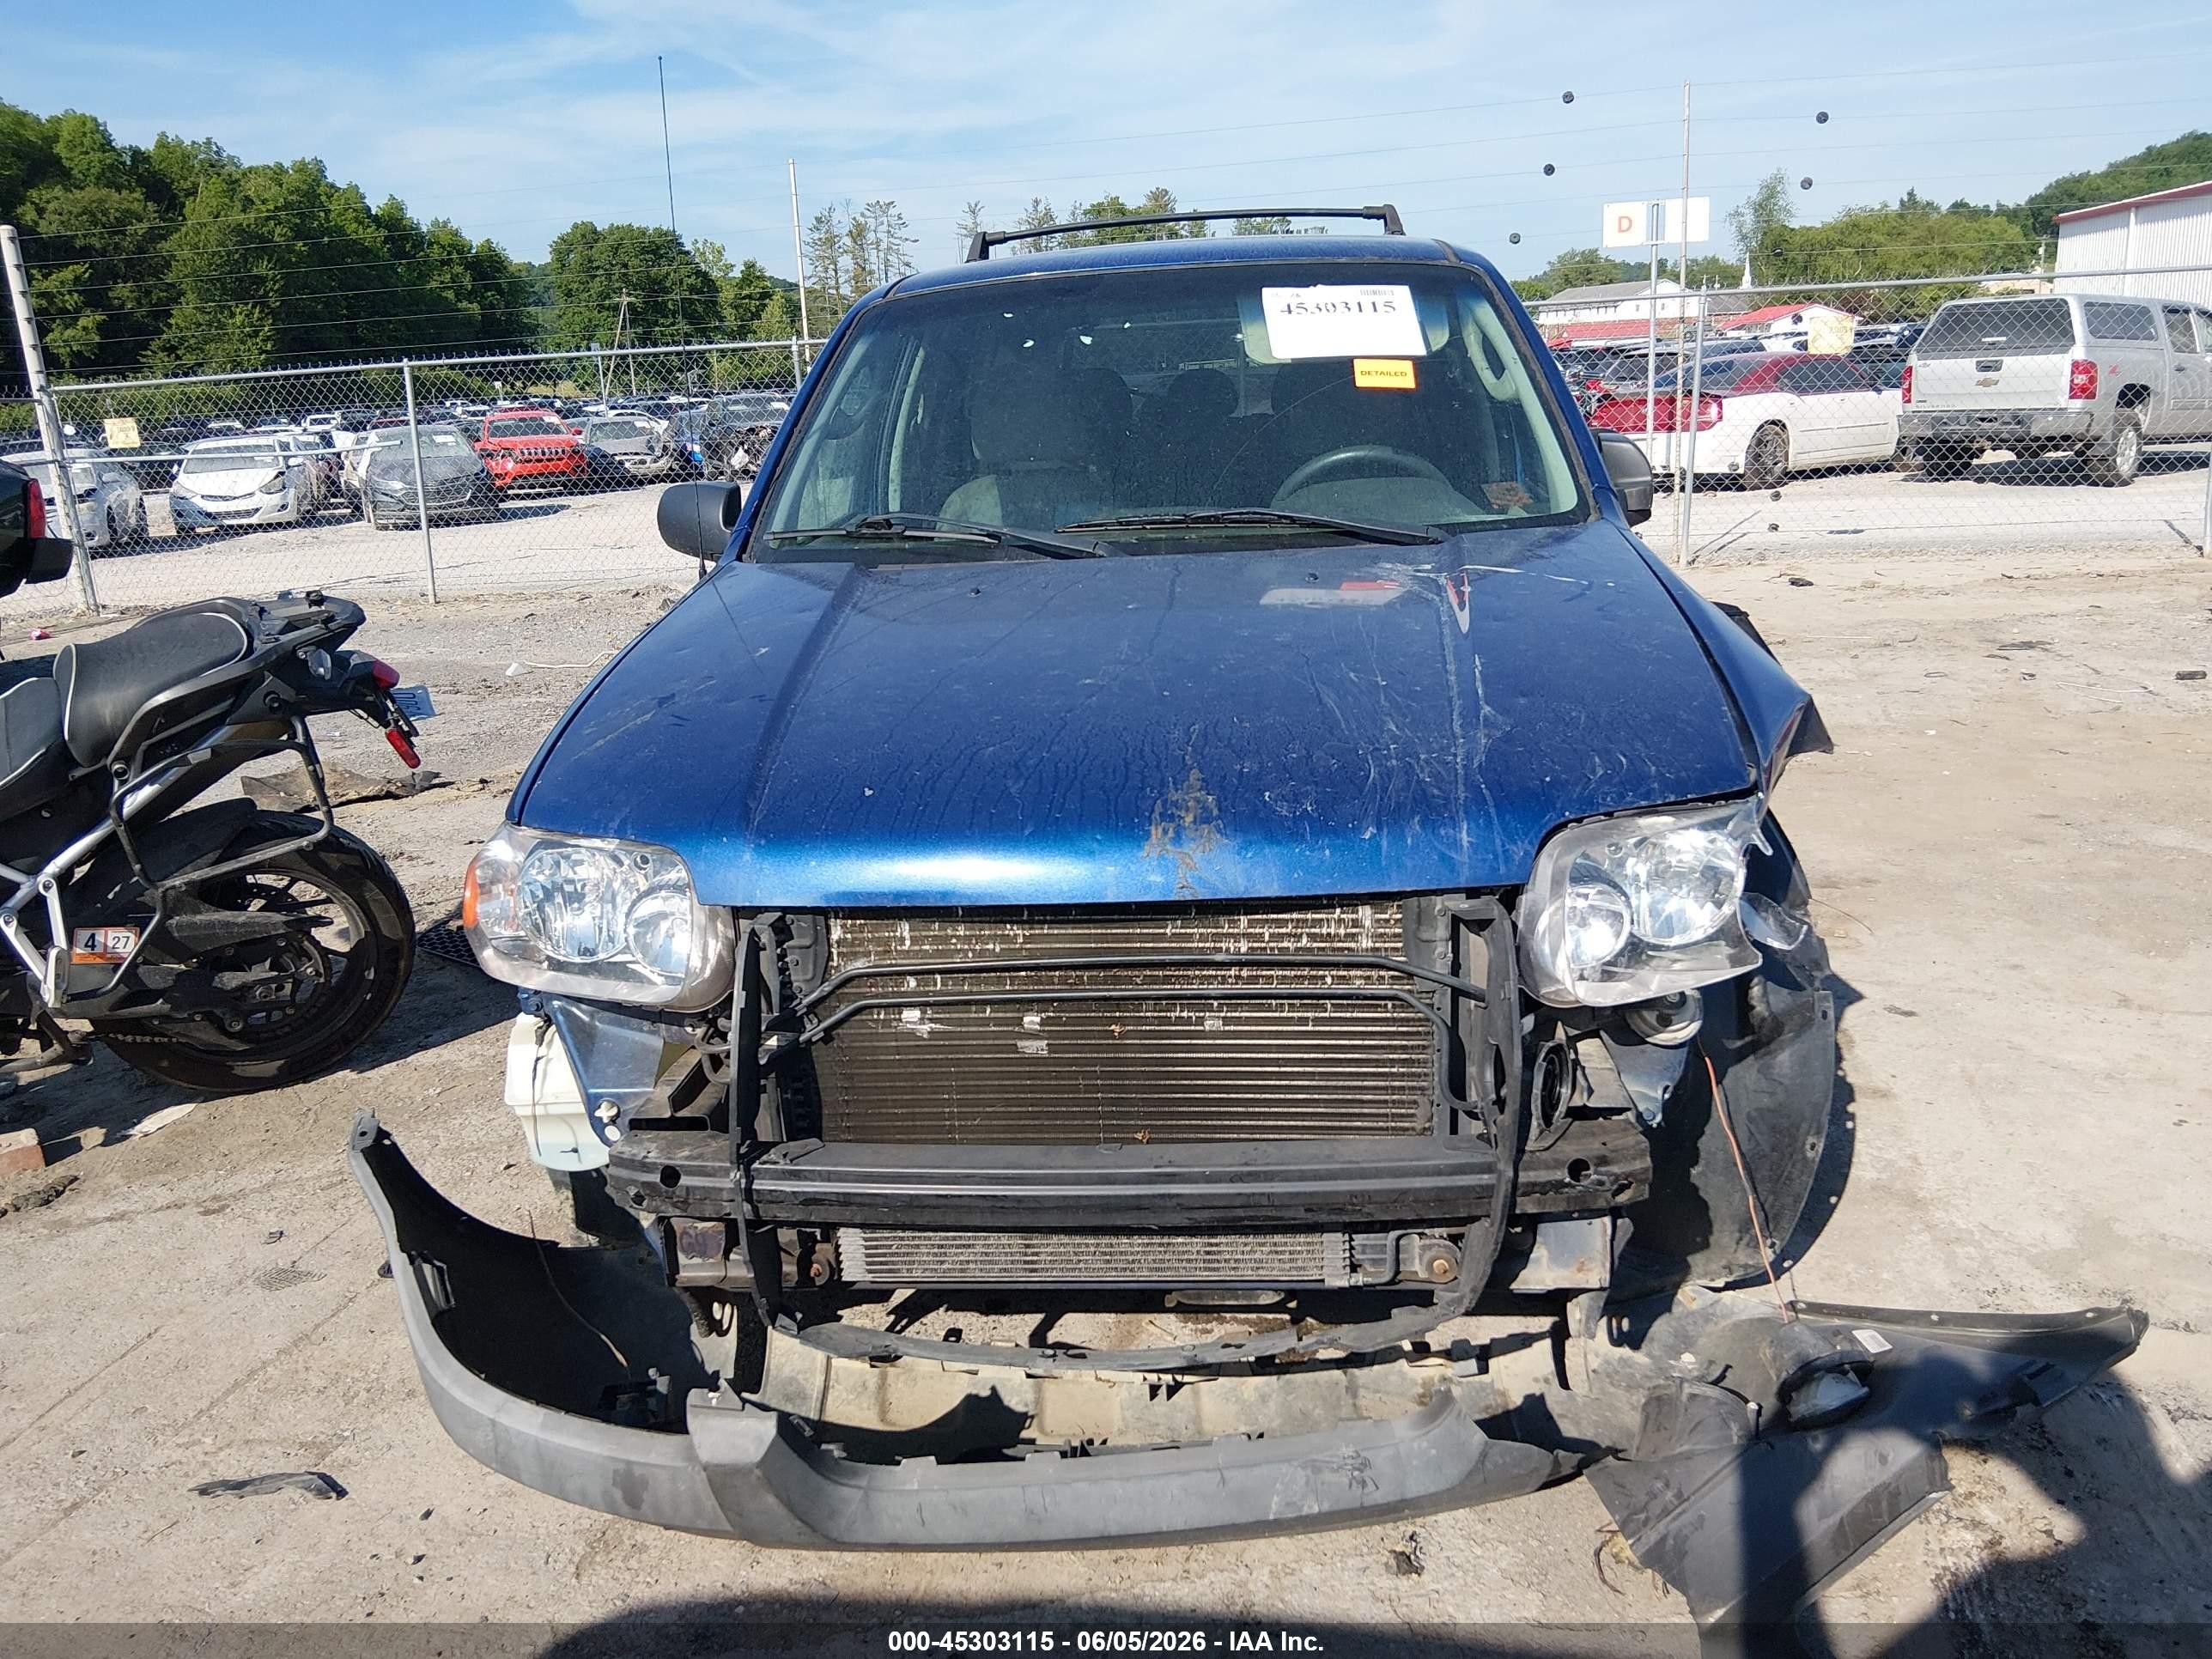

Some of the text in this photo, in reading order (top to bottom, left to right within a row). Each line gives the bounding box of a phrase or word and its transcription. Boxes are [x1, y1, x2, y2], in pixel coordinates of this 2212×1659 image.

[1618, 216, 1633, 234] D
[1280, 301, 1397, 315] 45303115
[84, 933, 131, 951] 4 27
